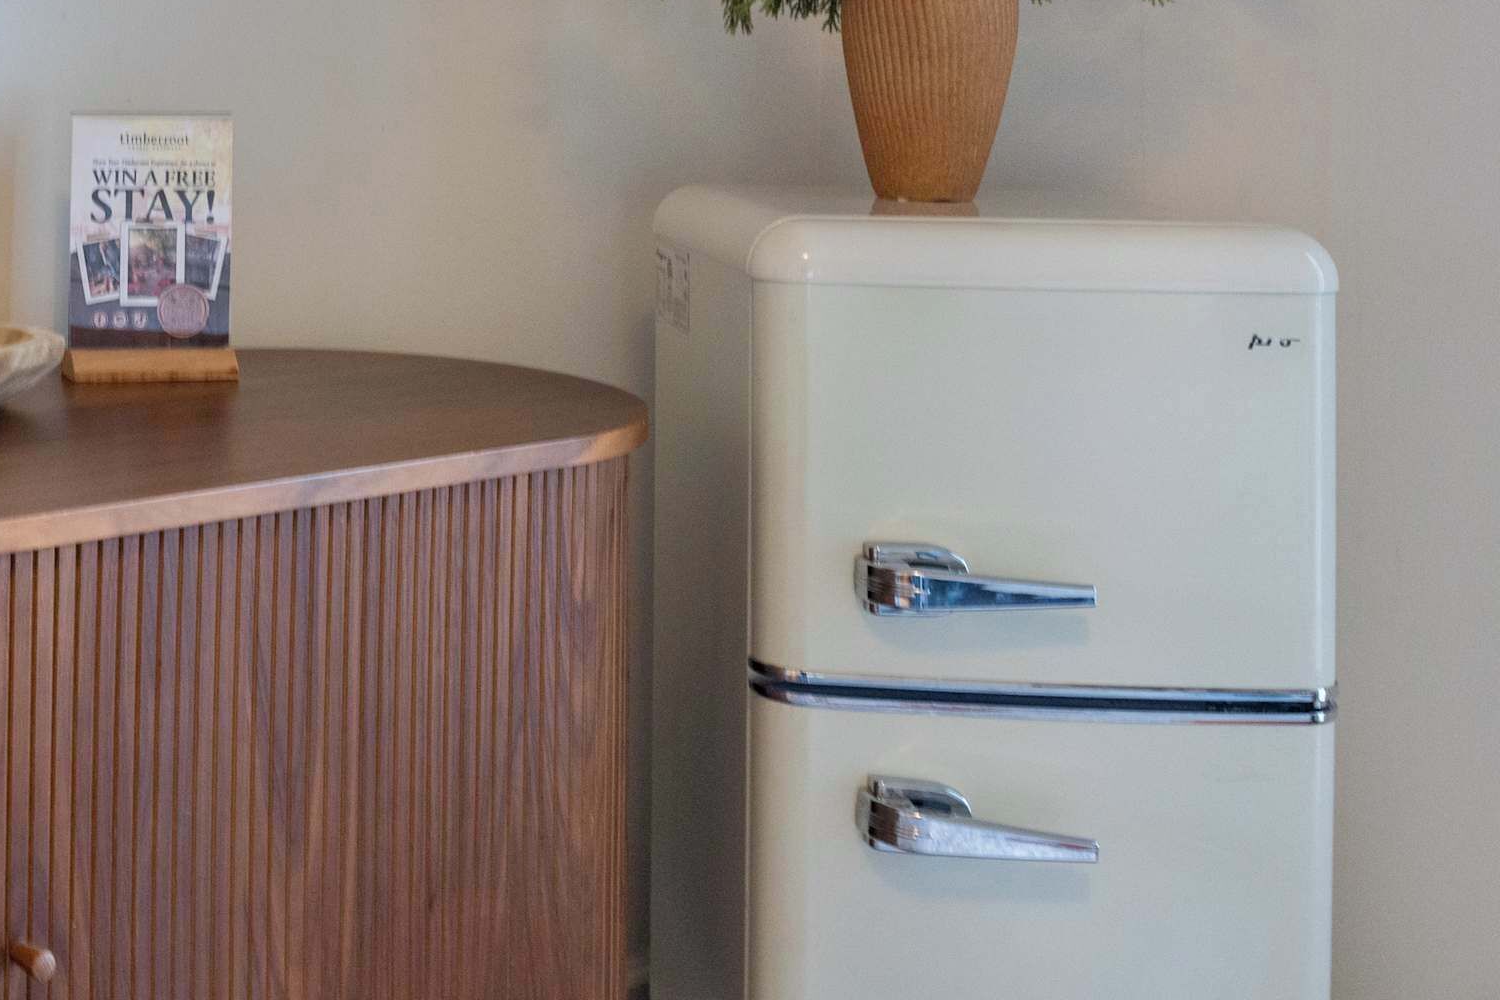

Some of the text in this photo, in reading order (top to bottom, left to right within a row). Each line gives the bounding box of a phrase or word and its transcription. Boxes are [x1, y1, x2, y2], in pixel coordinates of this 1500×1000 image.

[92, 168, 217, 187] WIN A FREE
[89, 187, 216, 225] STAY!
